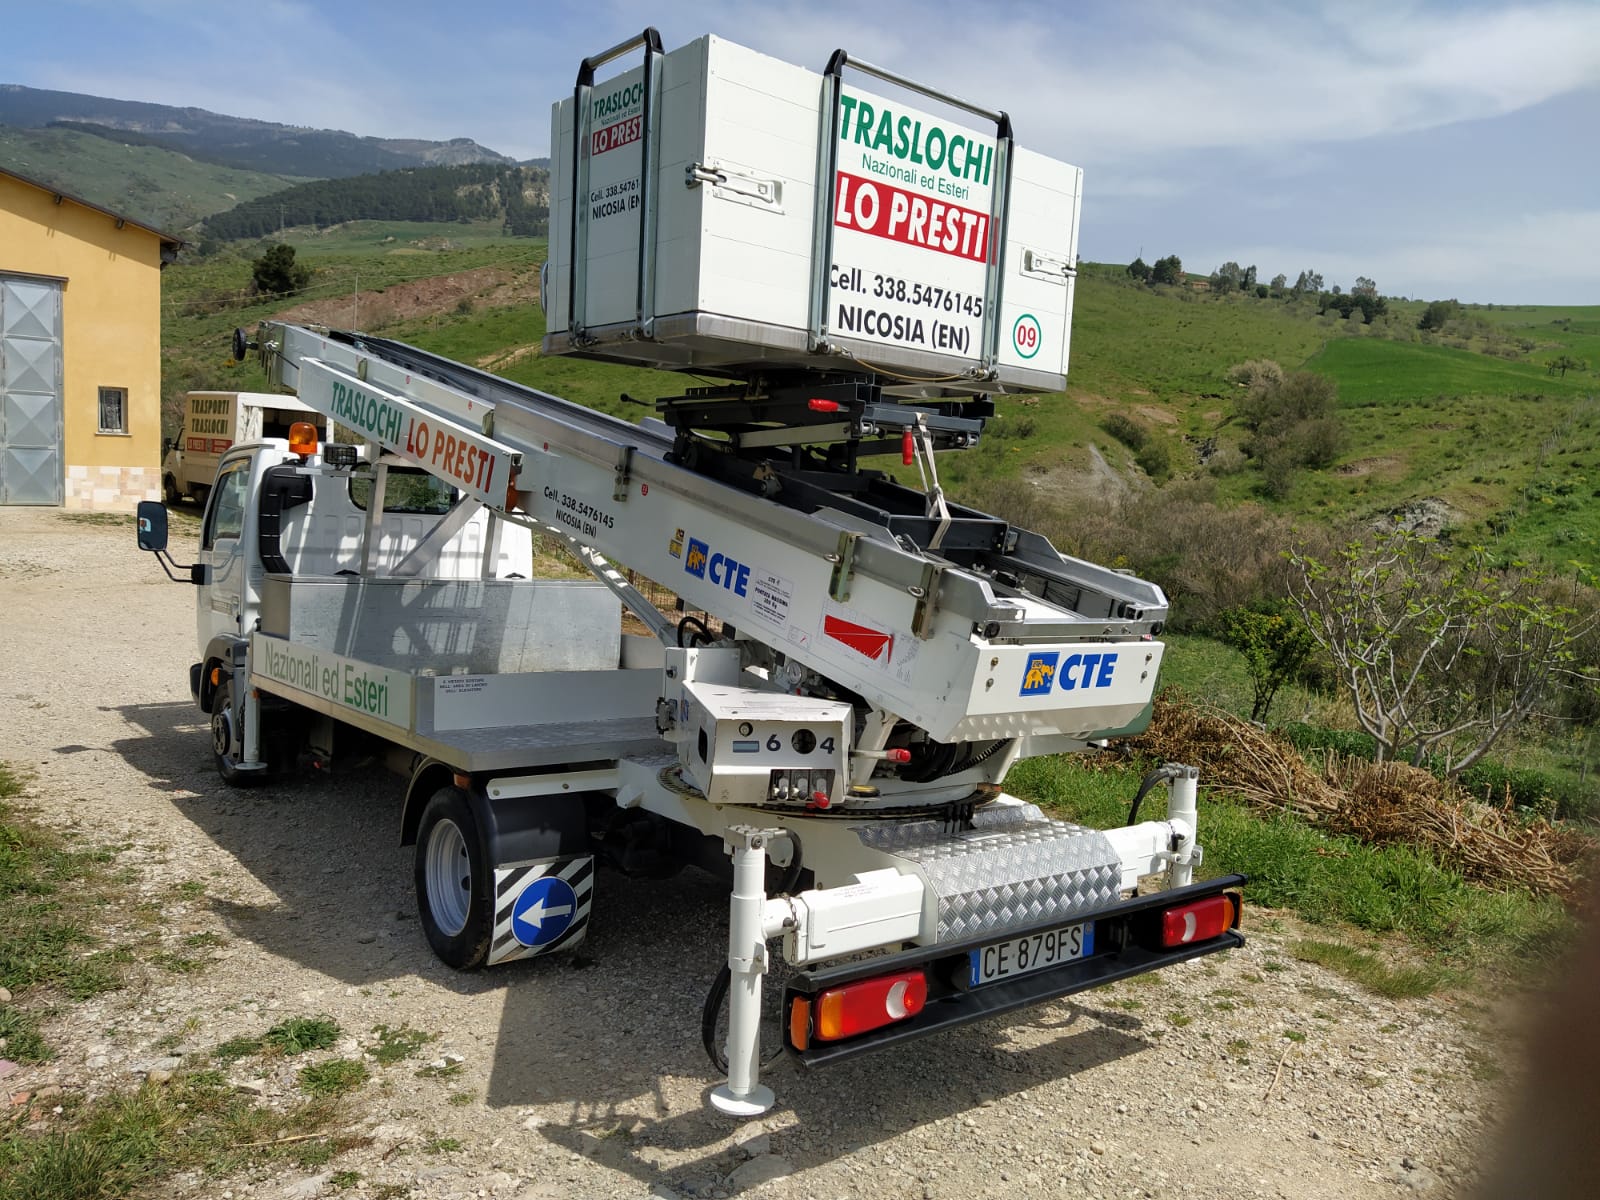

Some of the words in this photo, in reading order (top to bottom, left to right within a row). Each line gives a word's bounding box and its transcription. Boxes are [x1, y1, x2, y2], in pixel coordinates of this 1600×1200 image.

[593, 130, 608, 153] LO
[841, 94, 993, 186] TRASLOCHI
[591, 190, 603, 203] Cell.
[605, 178, 640, 198] 338.54761
[862, 152, 917, 184] Nazionali
[920, 175, 935, 189] ed
[938, 177, 969, 200] Esteri
[592, 198, 626, 220] NICOSIA
[836, 177, 880, 230] LO
[887, 191, 986, 258] PRESTI
[830, 264, 866, 294] Cell.
[873, 274, 983, 318] 338.5476145
[838, 304, 925, 344] NICOSIA
[931, 319, 970, 354] (EN)
[1017, 325, 1036, 347] 09
[192, 400, 230, 415] TRASPORTI
[192, 418, 228, 434] TRASLOCHI
[330, 381, 403, 445] TRASLOCHI
[406, 418, 430, 459] LO
[432, 430, 496, 493] PRESTI
[544, 486, 560, 503] Cell.
[561, 494, 614, 529] 338.5476145
[555, 508, 581, 531] NICOSIA
[583, 521, 597, 538] (EN)
[709, 553, 751, 598] CTE
[265, 641, 318, 692] Nazionali
[322, 662, 339, 699] ed
[344, 664, 388, 716] Esteri
[1059, 653, 1118, 691] CTE
[766, 734, 781, 751] 6
[819, 737, 835, 754] 4
[984, 943, 1010, 978] CE
[1018, 926, 1081, 969] 879FS
